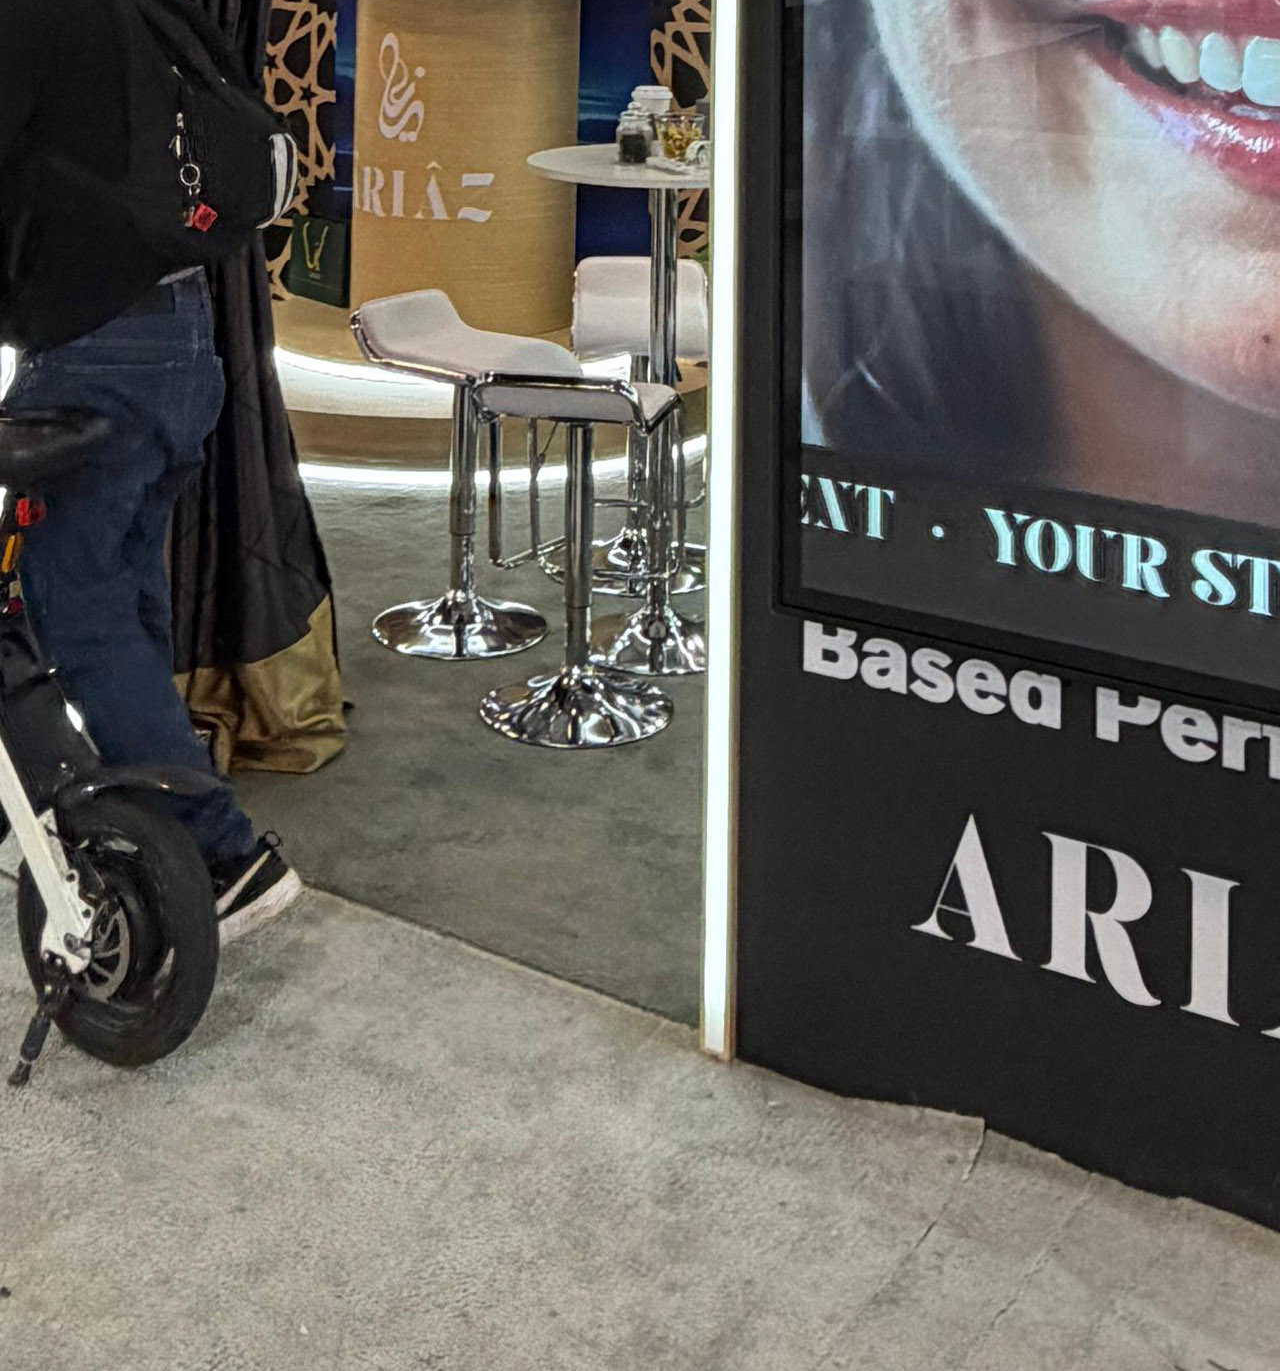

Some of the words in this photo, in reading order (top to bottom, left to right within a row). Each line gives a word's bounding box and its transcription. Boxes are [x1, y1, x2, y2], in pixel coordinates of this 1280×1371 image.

[353, 150, 495, 223] RIÂZ
[983, 506, 1171, 599] YOUR
[802, 619, 1062, 730] Based
